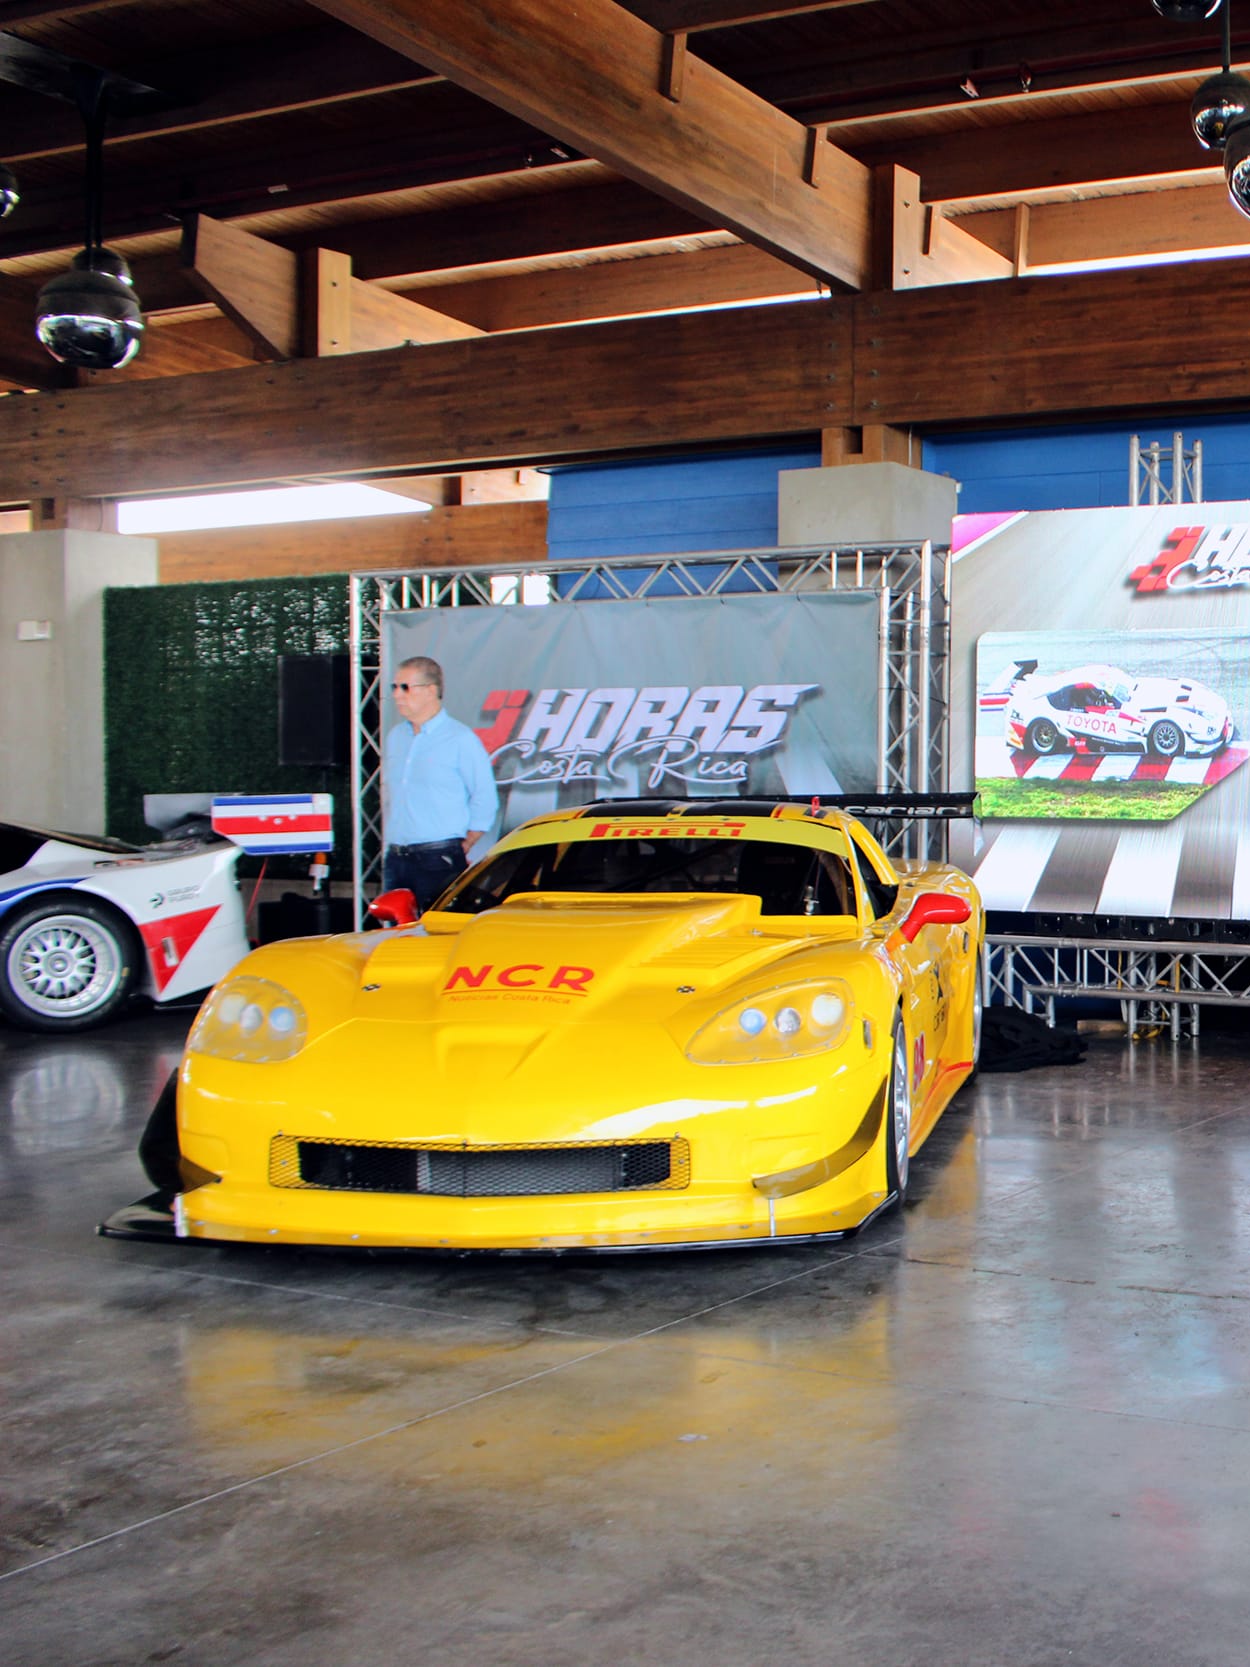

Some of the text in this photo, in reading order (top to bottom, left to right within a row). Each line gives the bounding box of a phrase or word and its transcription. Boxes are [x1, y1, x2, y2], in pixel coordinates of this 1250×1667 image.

[518, 684, 820, 753] HORAS
[1066, 714, 1118, 735] TOYOTA
[490, 736, 749, 788] Costa Rica
[590, 822, 747, 838] PIRELLI
[443, 964, 596, 993] NCR
